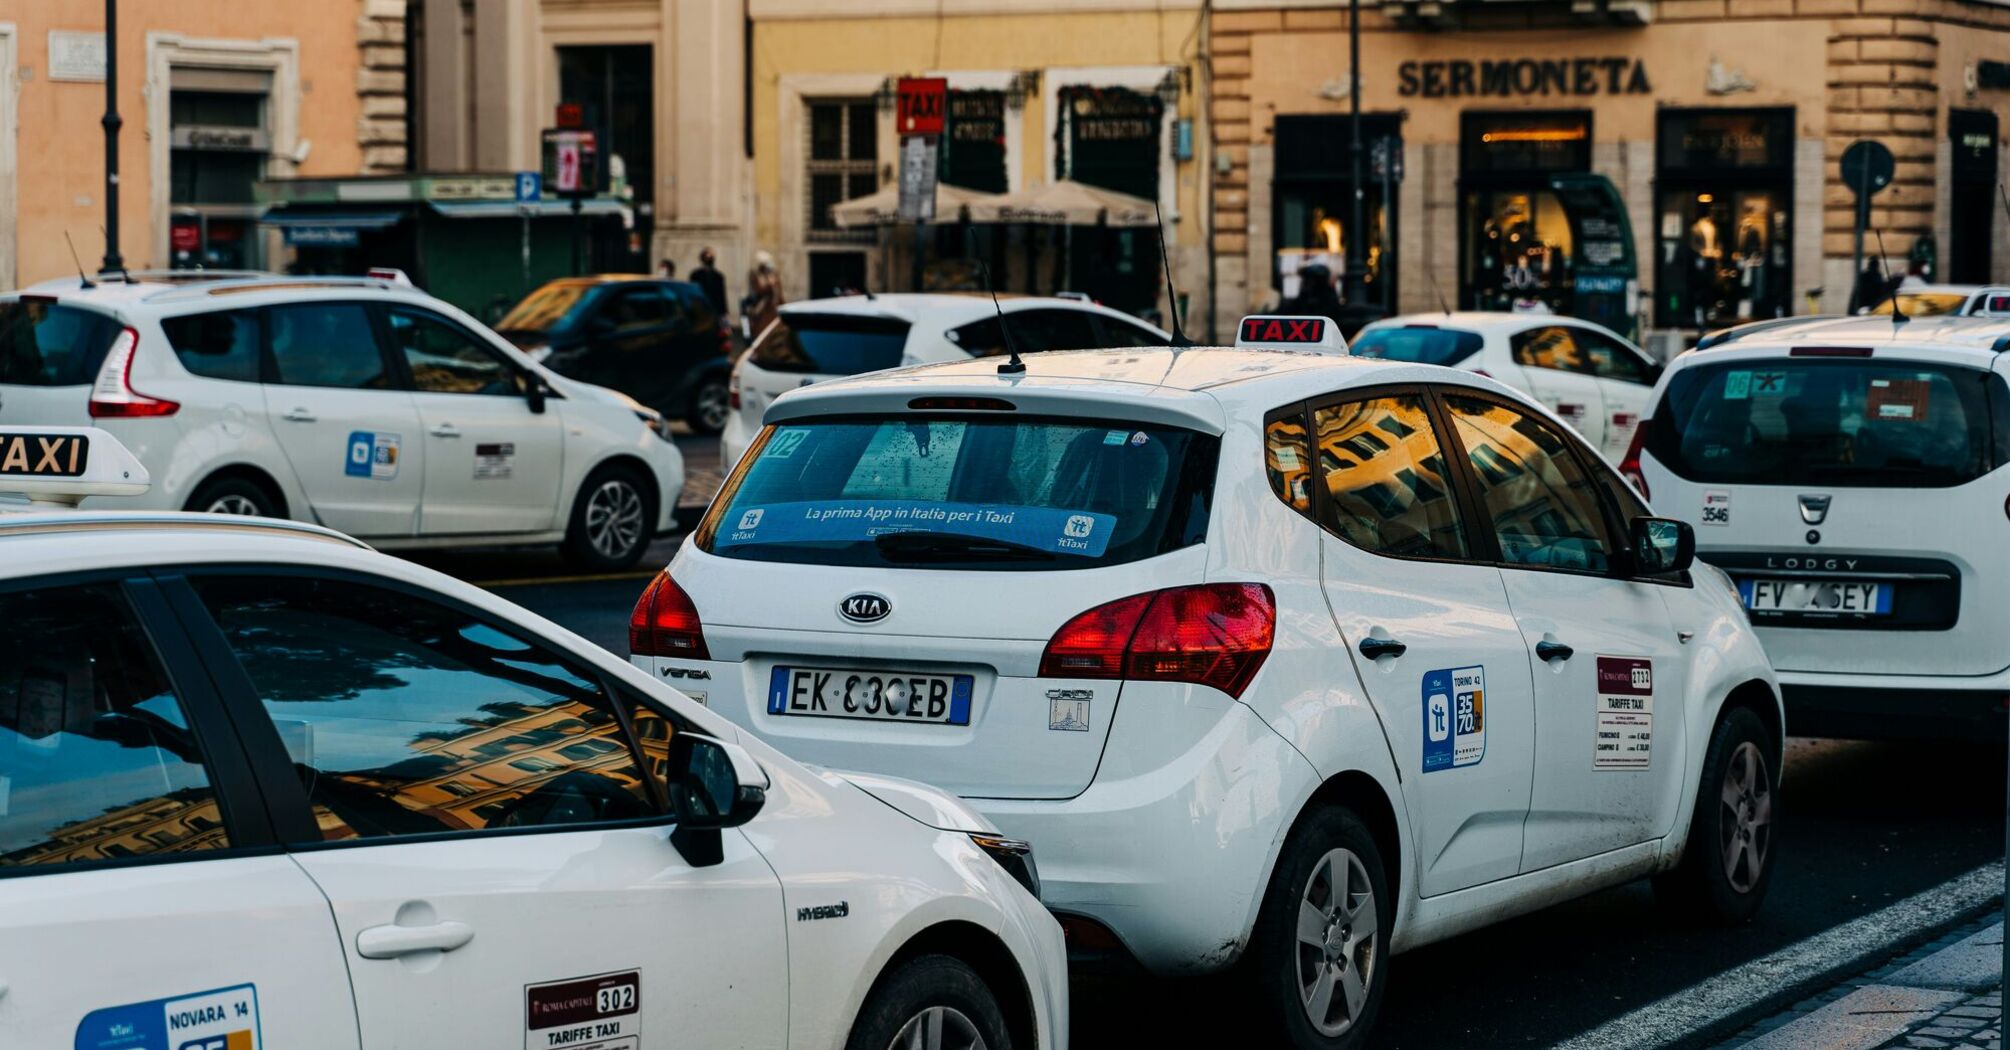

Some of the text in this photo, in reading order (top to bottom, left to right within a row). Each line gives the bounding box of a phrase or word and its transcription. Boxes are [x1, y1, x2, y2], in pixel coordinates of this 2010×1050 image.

[1398, 58, 1651, 97] SERMONETA
[901, 92, 943, 117] TAXI
[1245, 320, 1321, 341] TAXI
[0, 436, 79, 473] AXI
[768, 432, 805, 455] 02
[805, 507, 1015, 524] La prima App in Italia per i Taxi
[1703, 507, 1728, 522] 3546
[1767, 557, 1858, 570] LODGY
[1755, 582, 1786, 608] FV
[848, 599, 881, 615] KIA
[1454, 676, 1481, 687] TORINO 42
[1632, 671, 1649, 684] 2732
[791, 671, 831, 712] EK
[1458, 695, 1473, 715] 35
[1608, 698, 1644, 709] TARIFFE TAXI
[601, 986, 632, 1012] 302
[170, 1001, 248, 1030] NOVARA 14
[548, 1021, 620, 1046] TARIFFE TAXI
